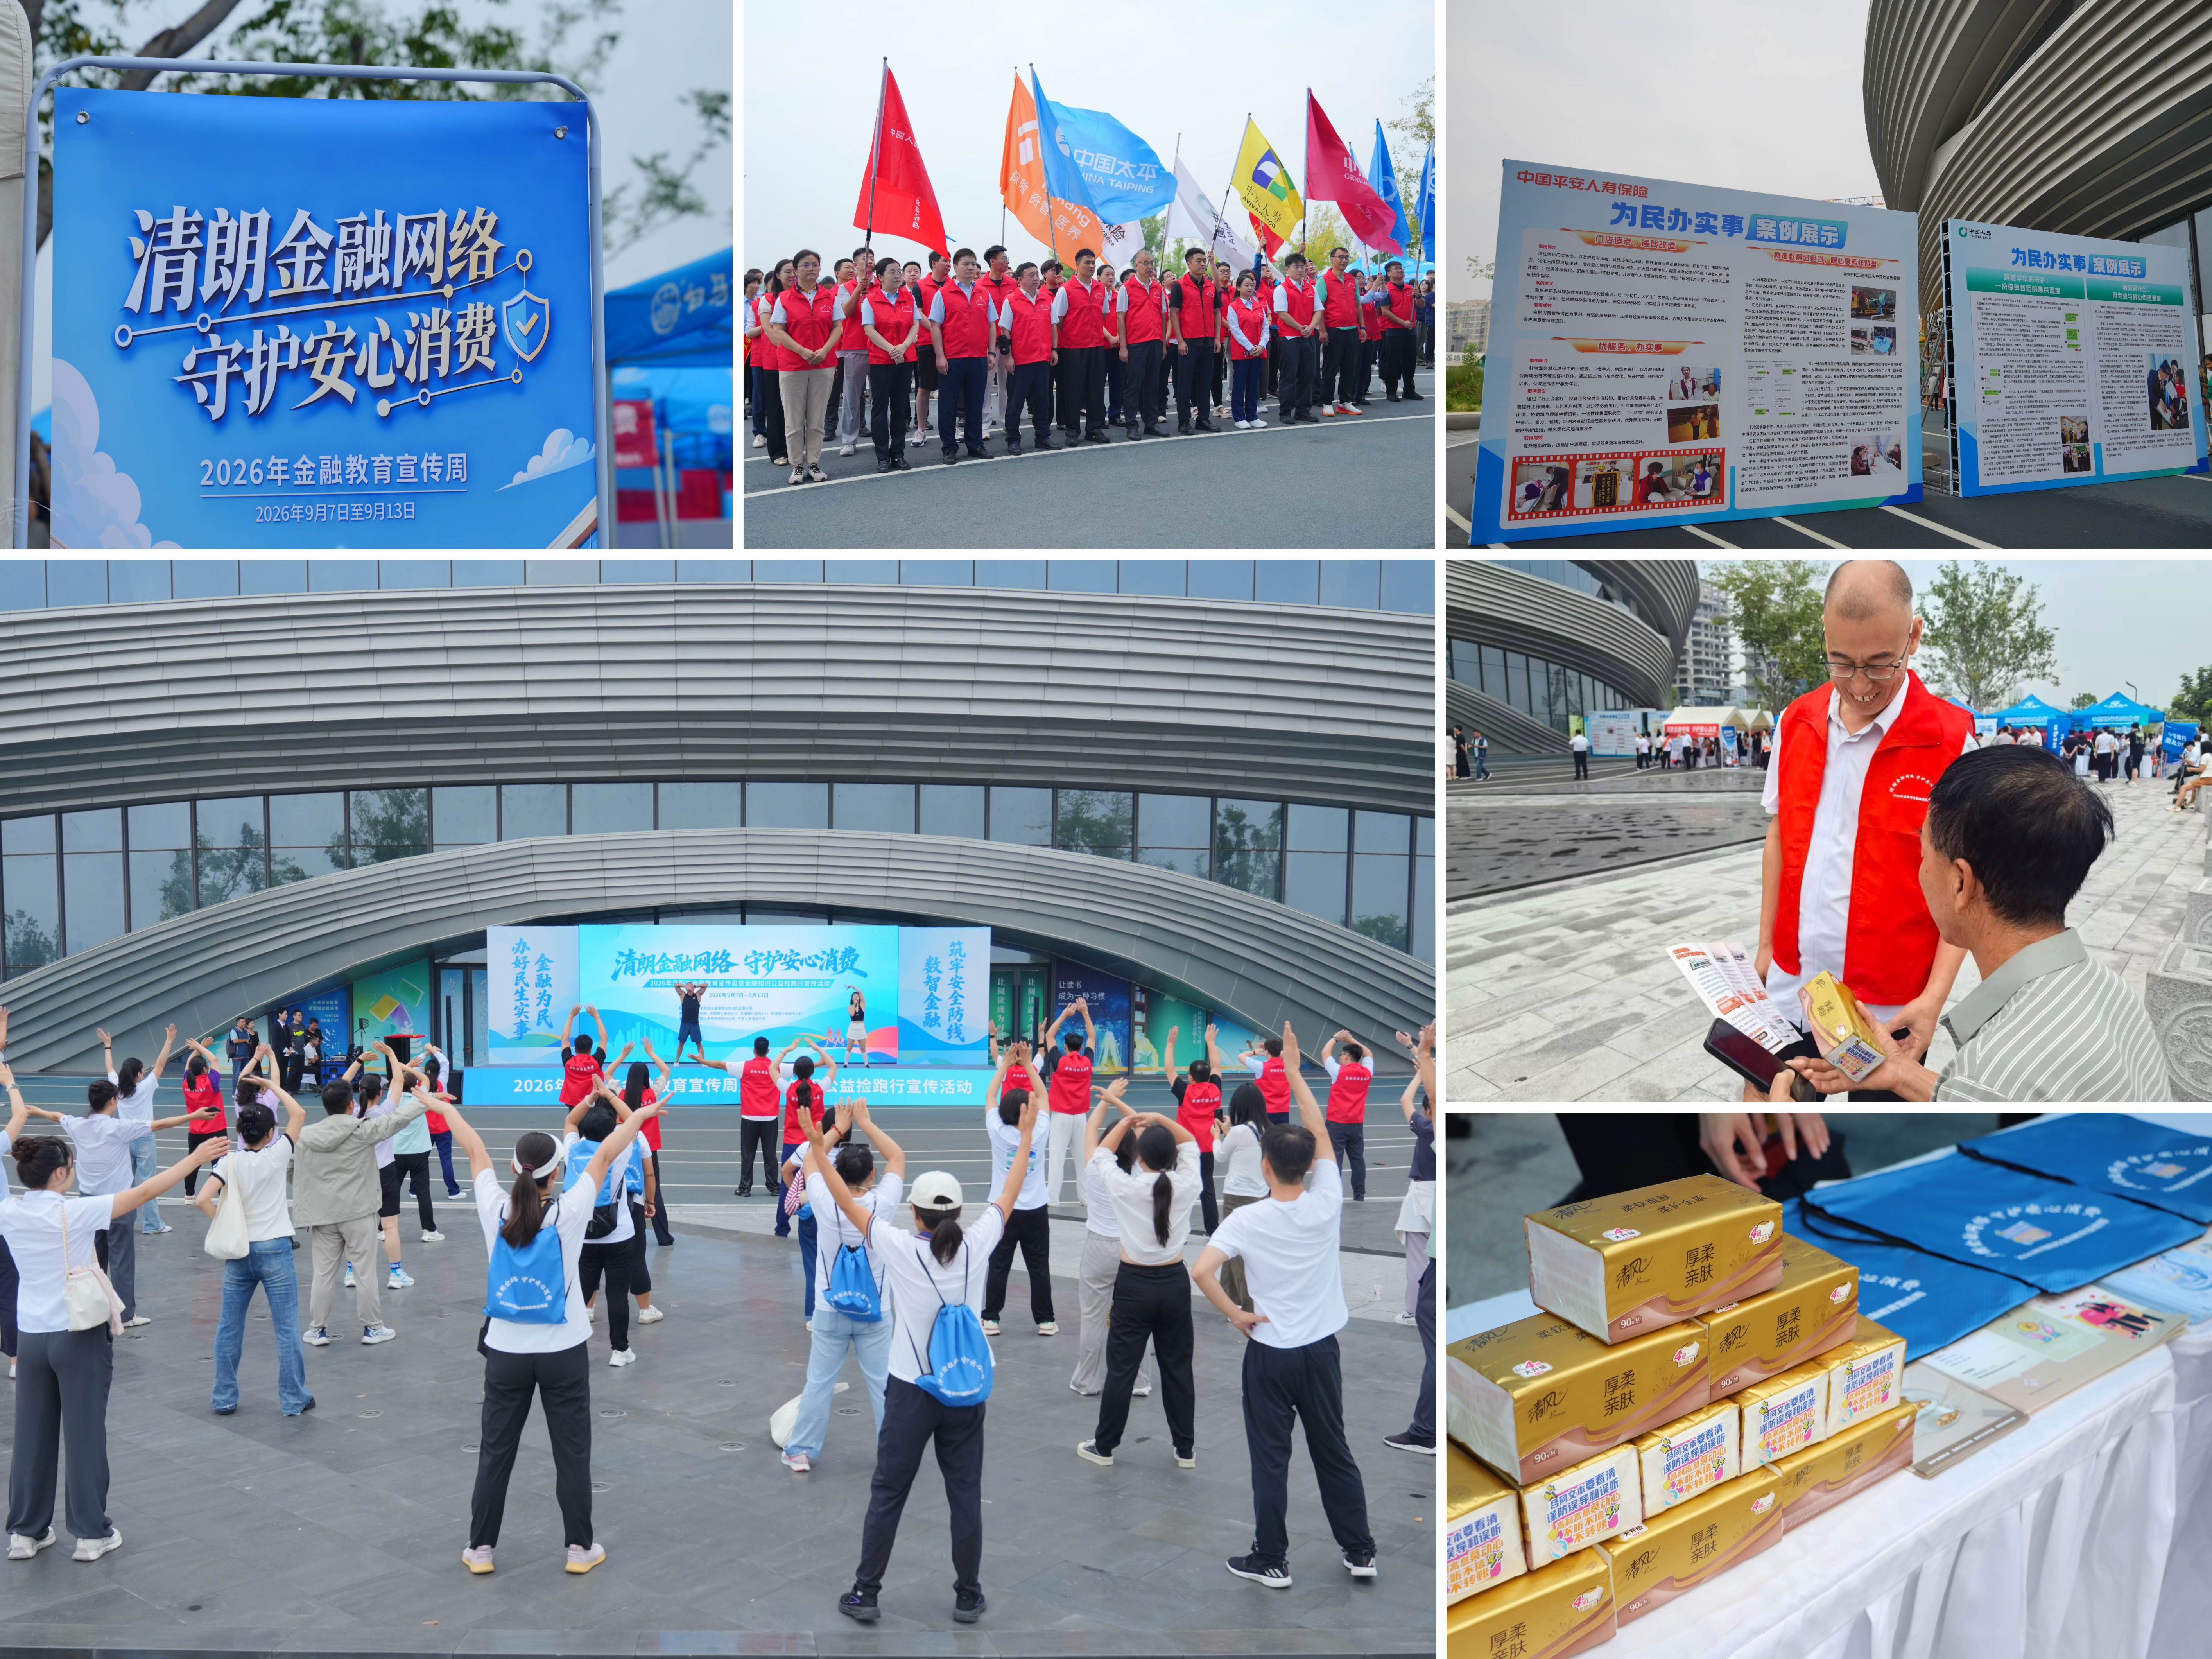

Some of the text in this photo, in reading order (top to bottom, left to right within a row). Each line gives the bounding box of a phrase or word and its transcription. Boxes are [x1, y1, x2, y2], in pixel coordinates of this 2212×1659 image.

[1074, 149, 1158, 181] 中国太平
[1082, 172, 1154, 194] HINA TAIPING
[1517, 170, 1648, 199] 中国平安人寿保险
[1009, 170, 1082, 240] 保险 资管 医养
[1246, 185, 1282, 223] 中英人寿
[1610, 201, 1839, 245] 为民办实事 案例展示
[1595, 235, 1676, 251] 门店适老、适残改造
[119, 205, 505, 314] 清朗金融网络
[1773, 251, 1877, 268] 急难救援显担当，暖心服务获赞誉
[2011, 248, 2142, 276] 为民办实事 案例展示
[1995, 283, 2061, 295] 一份保单背后的惠民温度
[2113, 292, 2162, 301] 用专业与耐心传递温度
[1598, 341, 1663, 352] 优服务、办实事
[168, 302, 497, 422] 守护安心消费
[200, 452, 469, 488] 2026年金融教育宣传周
[255, 501, 416, 523] 2026年9月7日至9月13日
[611, 946, 868, 981] 清朗金融网络 守护安心消费
[511, 938, 531, 1040] 办好民生实事
[534, 953, 555, 1029] 金融为民
[923, 955, 943, 1028] 数智金融
[946, 940, 966, 1043] 筑牢安全防线
[1058, 992, 1106, 1001] 成为一种习惯
[1059, 981, 1082, 989] 让读书
[1620, 1194, 1673, 1212] 柔软亲肤
[1656, 1195, 1708, 1214] 柔护全家
[1685, 1243, 1714, 1269] 厚柔
[1615, 1255, 1654, 1288] 清风
[1685, 1265, 1714, 1288] 亲肤
[1776, 1307, 1801, 1332] 厚柔
[1720, 1321, 1750, 1354] 清风
[1775, 1326, 1799, 1348] 亲肤
[1844, 1360, 1893, 1394] 谨防误导和误听
[1847, 1352, 1893, 1382] 合同文本要看清
[1604, 1369, 1635, 1398] 厚柔
[1849, 1372, 1893, 1401] 高利高息莫动心
[1852, 1388, 1880, 1406] 不听不信
[1528, 1387, 1569, 1424] 清风
[1604, 1390, 1635, 1417] 亲肤
[1760, 1397, 1815, 1435] 谨防误导和误听
[1763, 1387, 1814, 1423] 合同文本要看清
[1858, 1395, 1881, 1412] 不转账
[1766, 1410, 1816, 1442] 高利高息莫动心
[1770, 1426, 1802, 1447] 不听不信
[1663, 1433, 1725, 1475] 谨防误导和误听
[1666, 1424, 1723, 1462] 合同文本要看清
[1777, 1433, 1803, 1453] 不转账
[1846, 1443, 1862, 1461] 厚柔
[1671, 1447, 1726, 1483] 高利高息莫动心
[1676, 1464, 1712, 1487] 不听不信
[1550, 1467, 1615, 1509] 合同文本要看清
[1684, 1472, 1714, 1494] 不转账
[1547, 1477, 1619, 1524] 谨防误导和误听
[1556, 1492, 1621, 1530] 高利高息莫动心
[1563, 1510, 1604, 1537] 不听不信
[1574, 1521, 1607, 1543] 不转账
[1623, 1525, 1646, 1539] 大升级
[1690, 1523, 1718, 1550] 厚柔
[1447, 1539, 1504, 1573] 高息莫动心
[1626, 1545, 1660, 1582] 清风
[1690, 1539, 1717, 1566] 亲肤
[1450, 1568, 1490, 1594] 不转账
[1490, 1621, 1526, 1652] 厚柔
